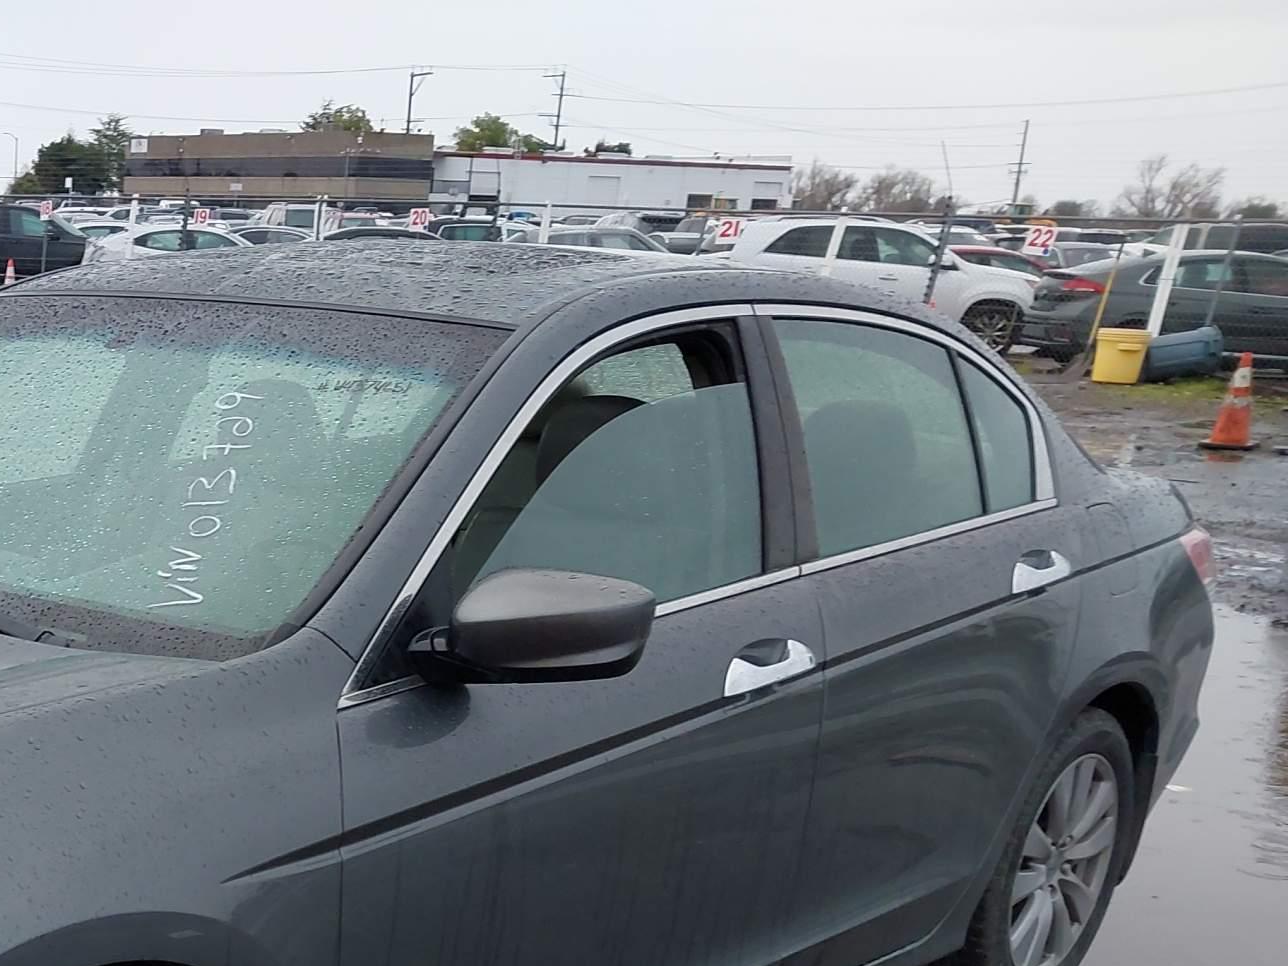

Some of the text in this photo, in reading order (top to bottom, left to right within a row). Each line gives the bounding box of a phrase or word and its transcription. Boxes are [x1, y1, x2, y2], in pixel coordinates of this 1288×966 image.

[195, 209, 208, 224] 19
[412, 209, 427, 226] 20
[719, 220, 741, 238] 21
[1027, 228, 1054, 248] 22
